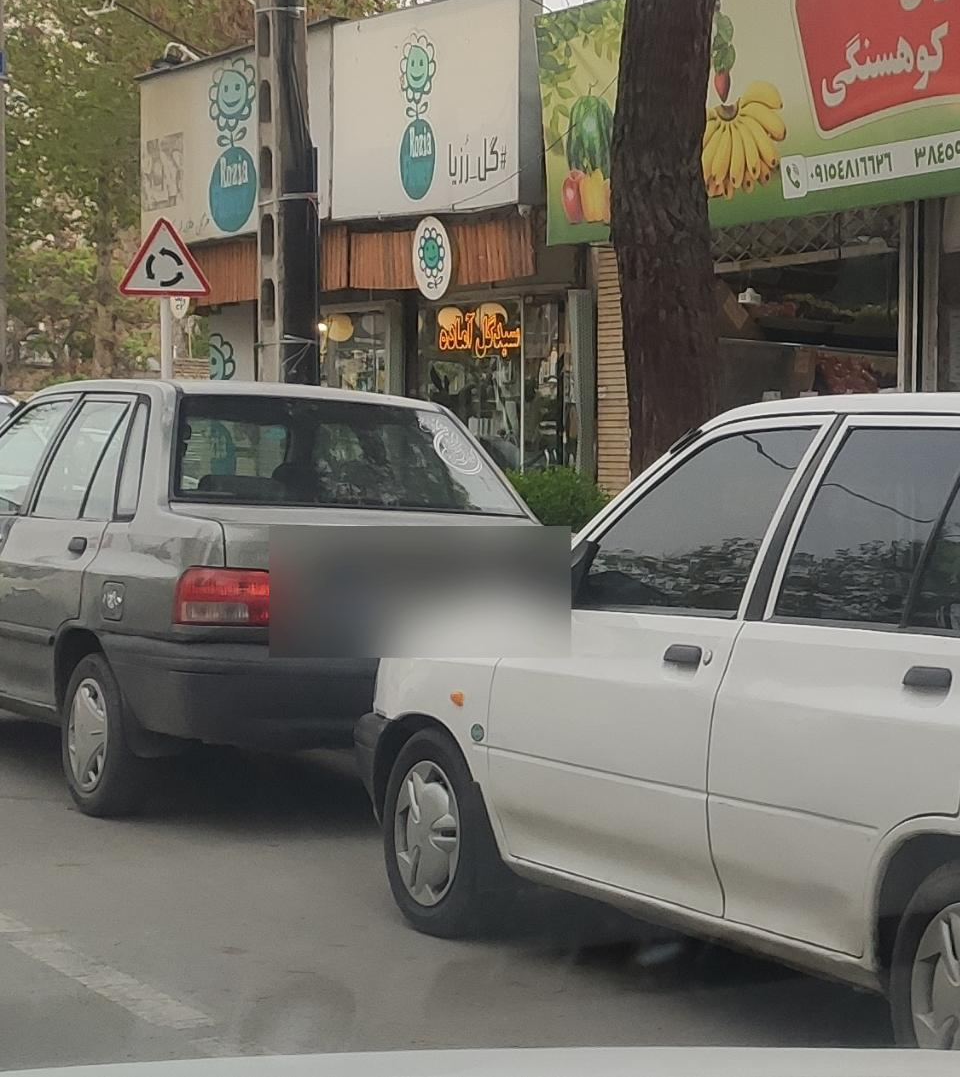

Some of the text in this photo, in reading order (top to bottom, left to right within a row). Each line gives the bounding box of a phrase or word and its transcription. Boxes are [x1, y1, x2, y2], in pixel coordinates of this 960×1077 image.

[822, 21, 949, 107] کوهسنگی
[408, 126, 432, 158] Rozia
[220, 154, 249, 188] Rozia
[439, 312, 476, 351] آماده
